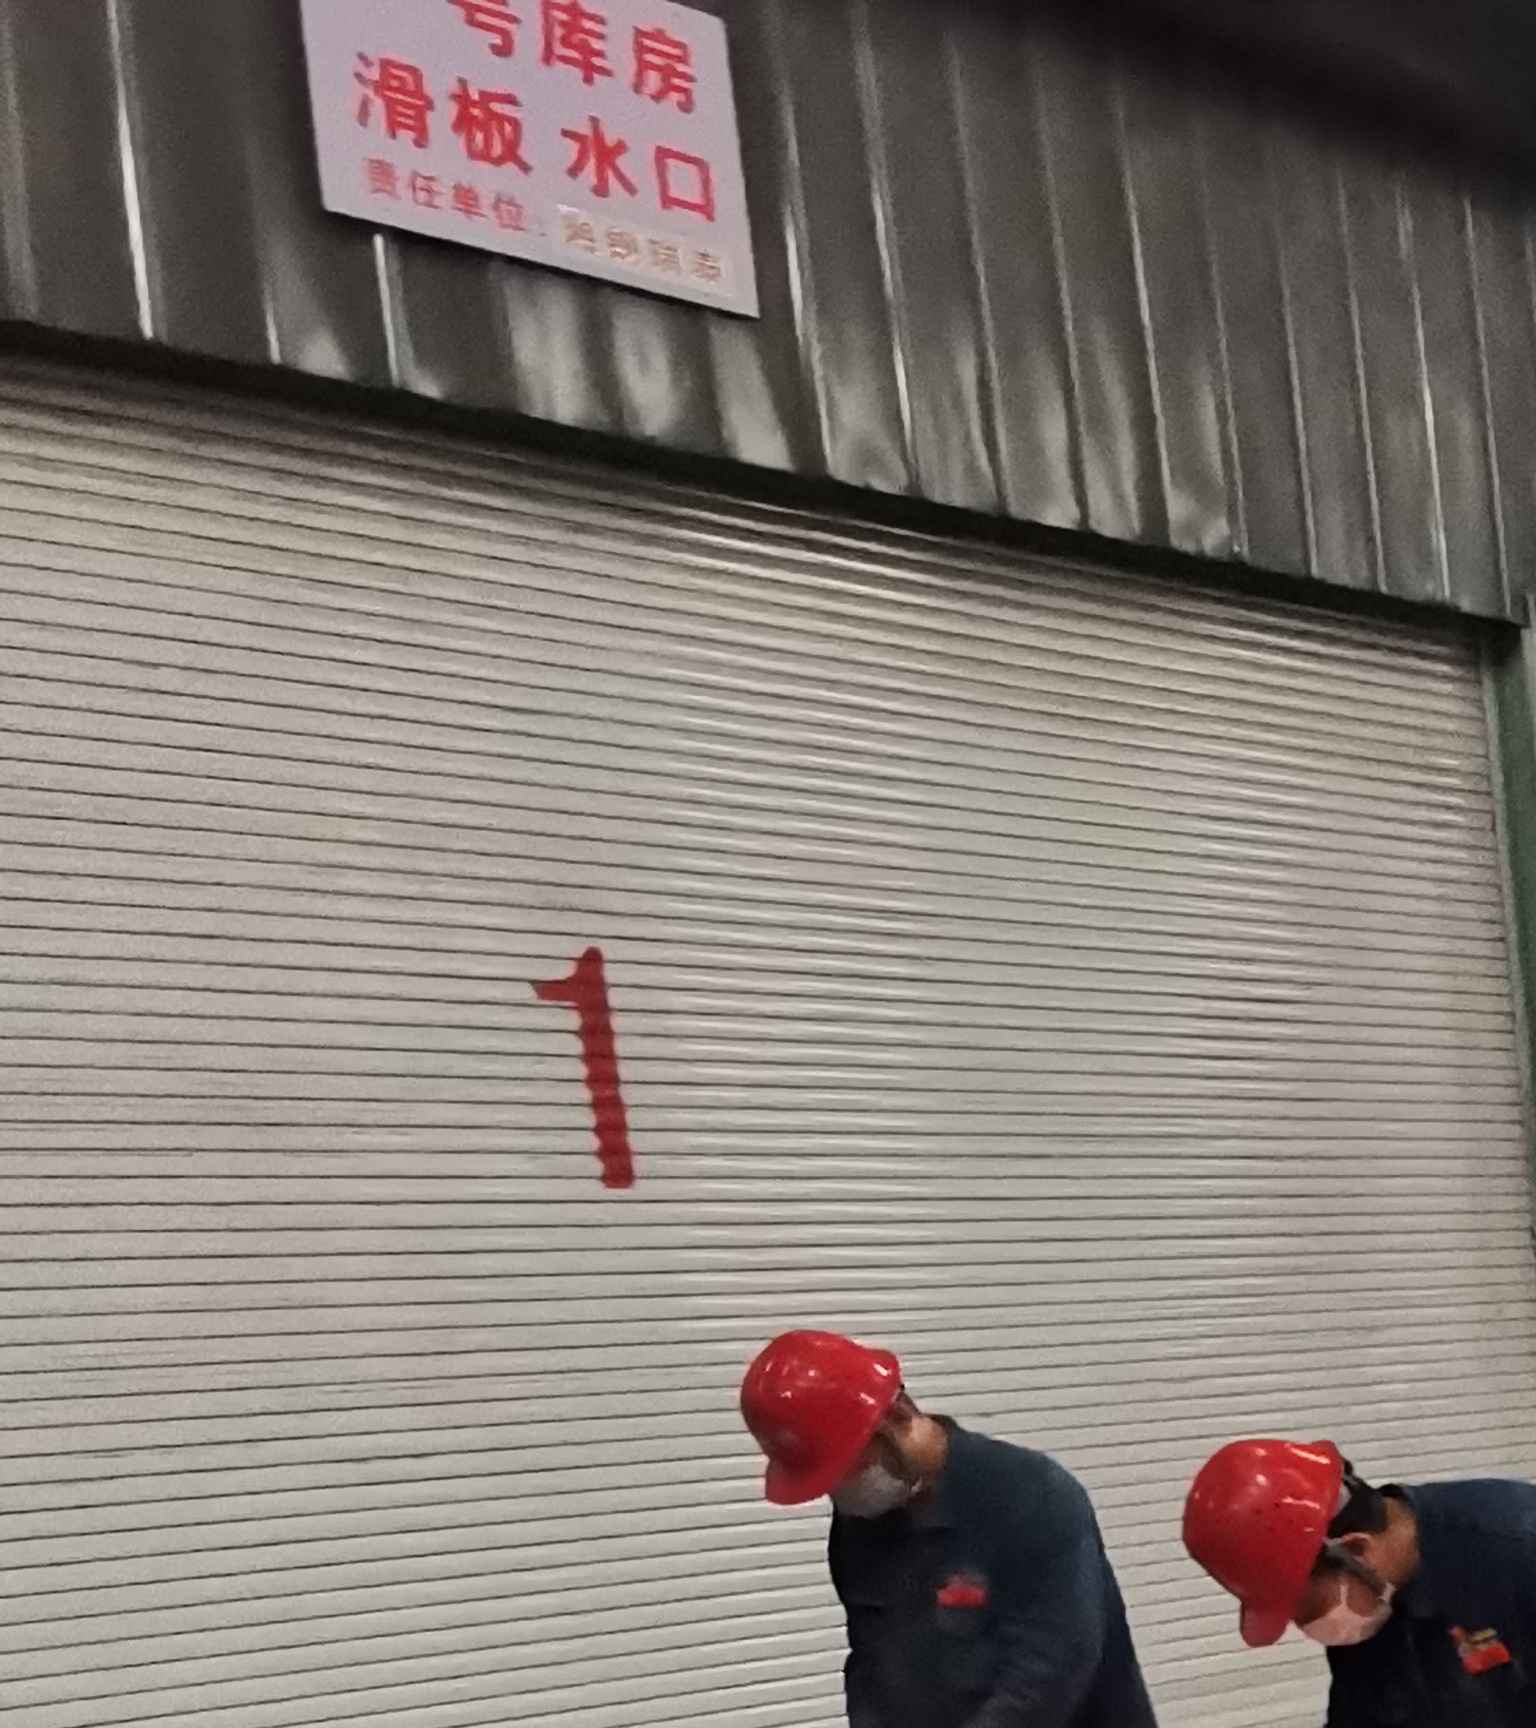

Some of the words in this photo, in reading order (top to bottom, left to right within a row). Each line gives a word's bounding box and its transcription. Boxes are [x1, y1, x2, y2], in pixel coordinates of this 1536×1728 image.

[354, 51, 716, 223] 滑板水口
[447, 0, 697, 114] 号库房
[529, 946, 637, 1190] 1
